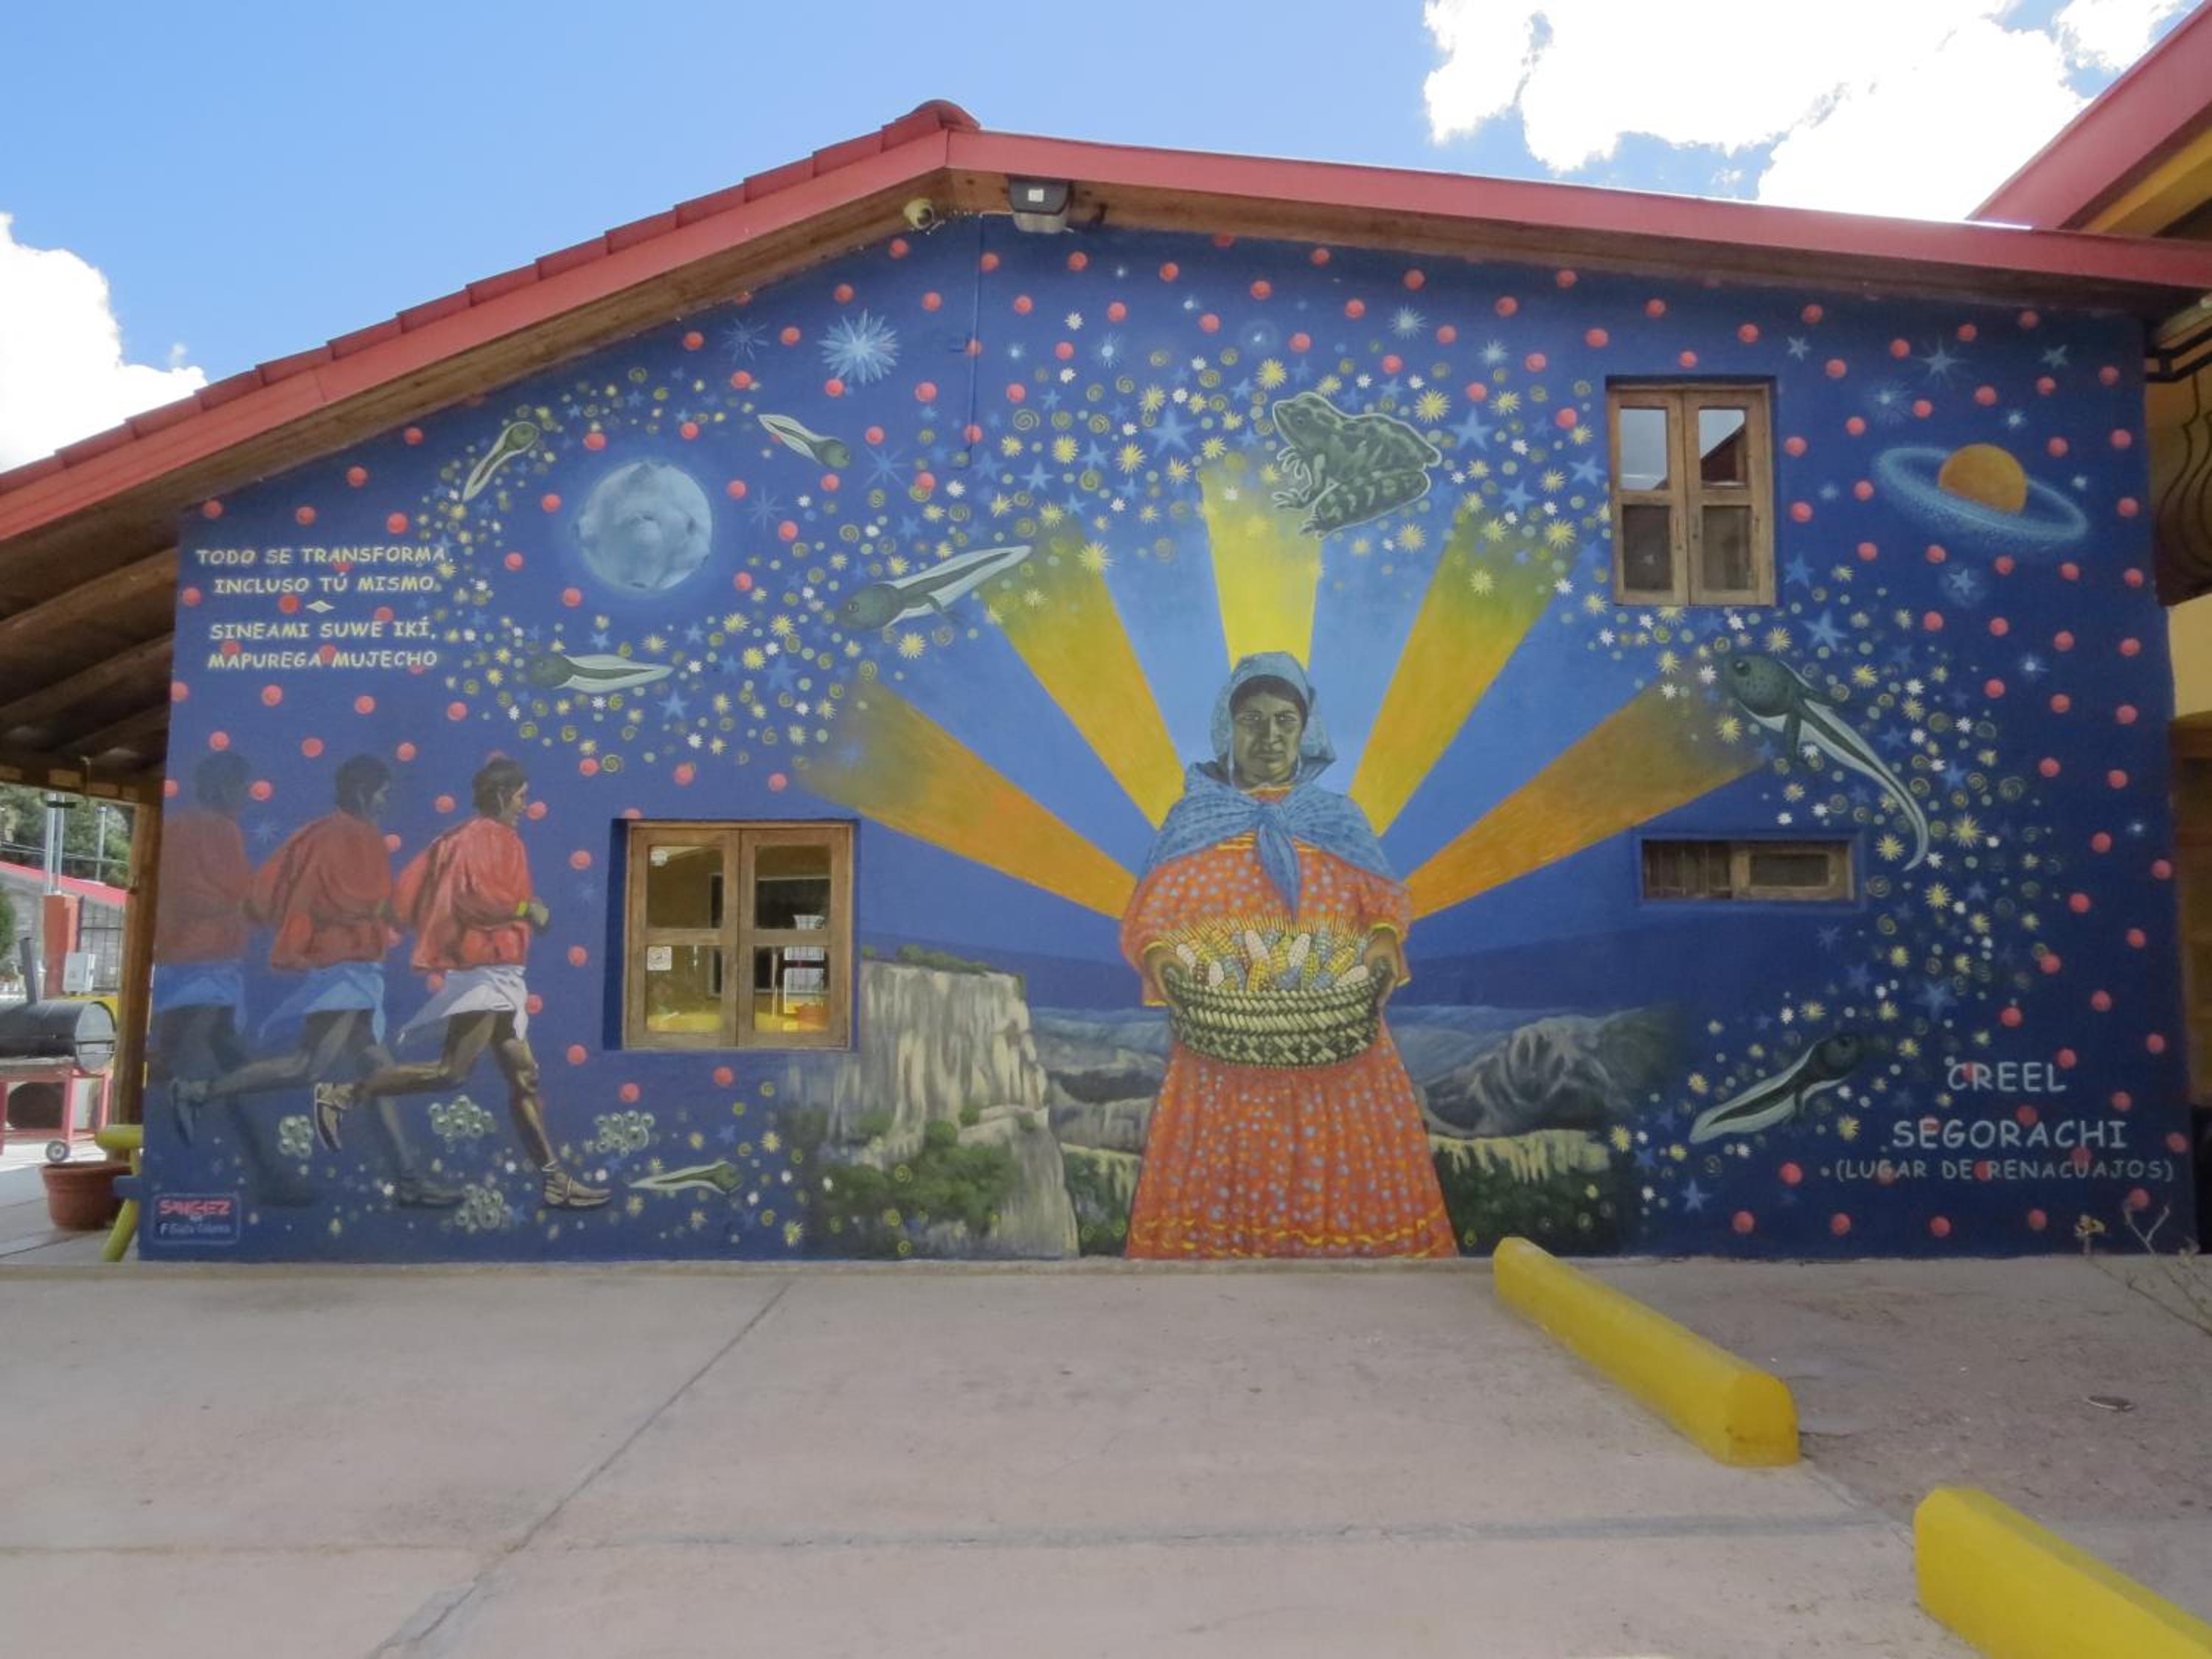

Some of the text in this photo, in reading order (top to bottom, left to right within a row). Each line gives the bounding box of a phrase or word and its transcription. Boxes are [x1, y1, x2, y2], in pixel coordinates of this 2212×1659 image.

[196, 549, 256, 566] TODO
[265, 548, 292, 565] SE
[213, 577, 310, 594] INCLUSO
[319, 571, 348, 592] TÚ
[209, 623, 310, 640] SINEAMI
[319, 622, 383, 639] SUWE
[207, 650, 437, 669] MAPUREGA MUJECHO
[1947, 1061, 2067, 1093] CREEL
[1892, 1119, 2128, 1150] SEGORACHI
[1836, 1158, 2174, 1182] (LUGAR DE RENACUAJOS)
